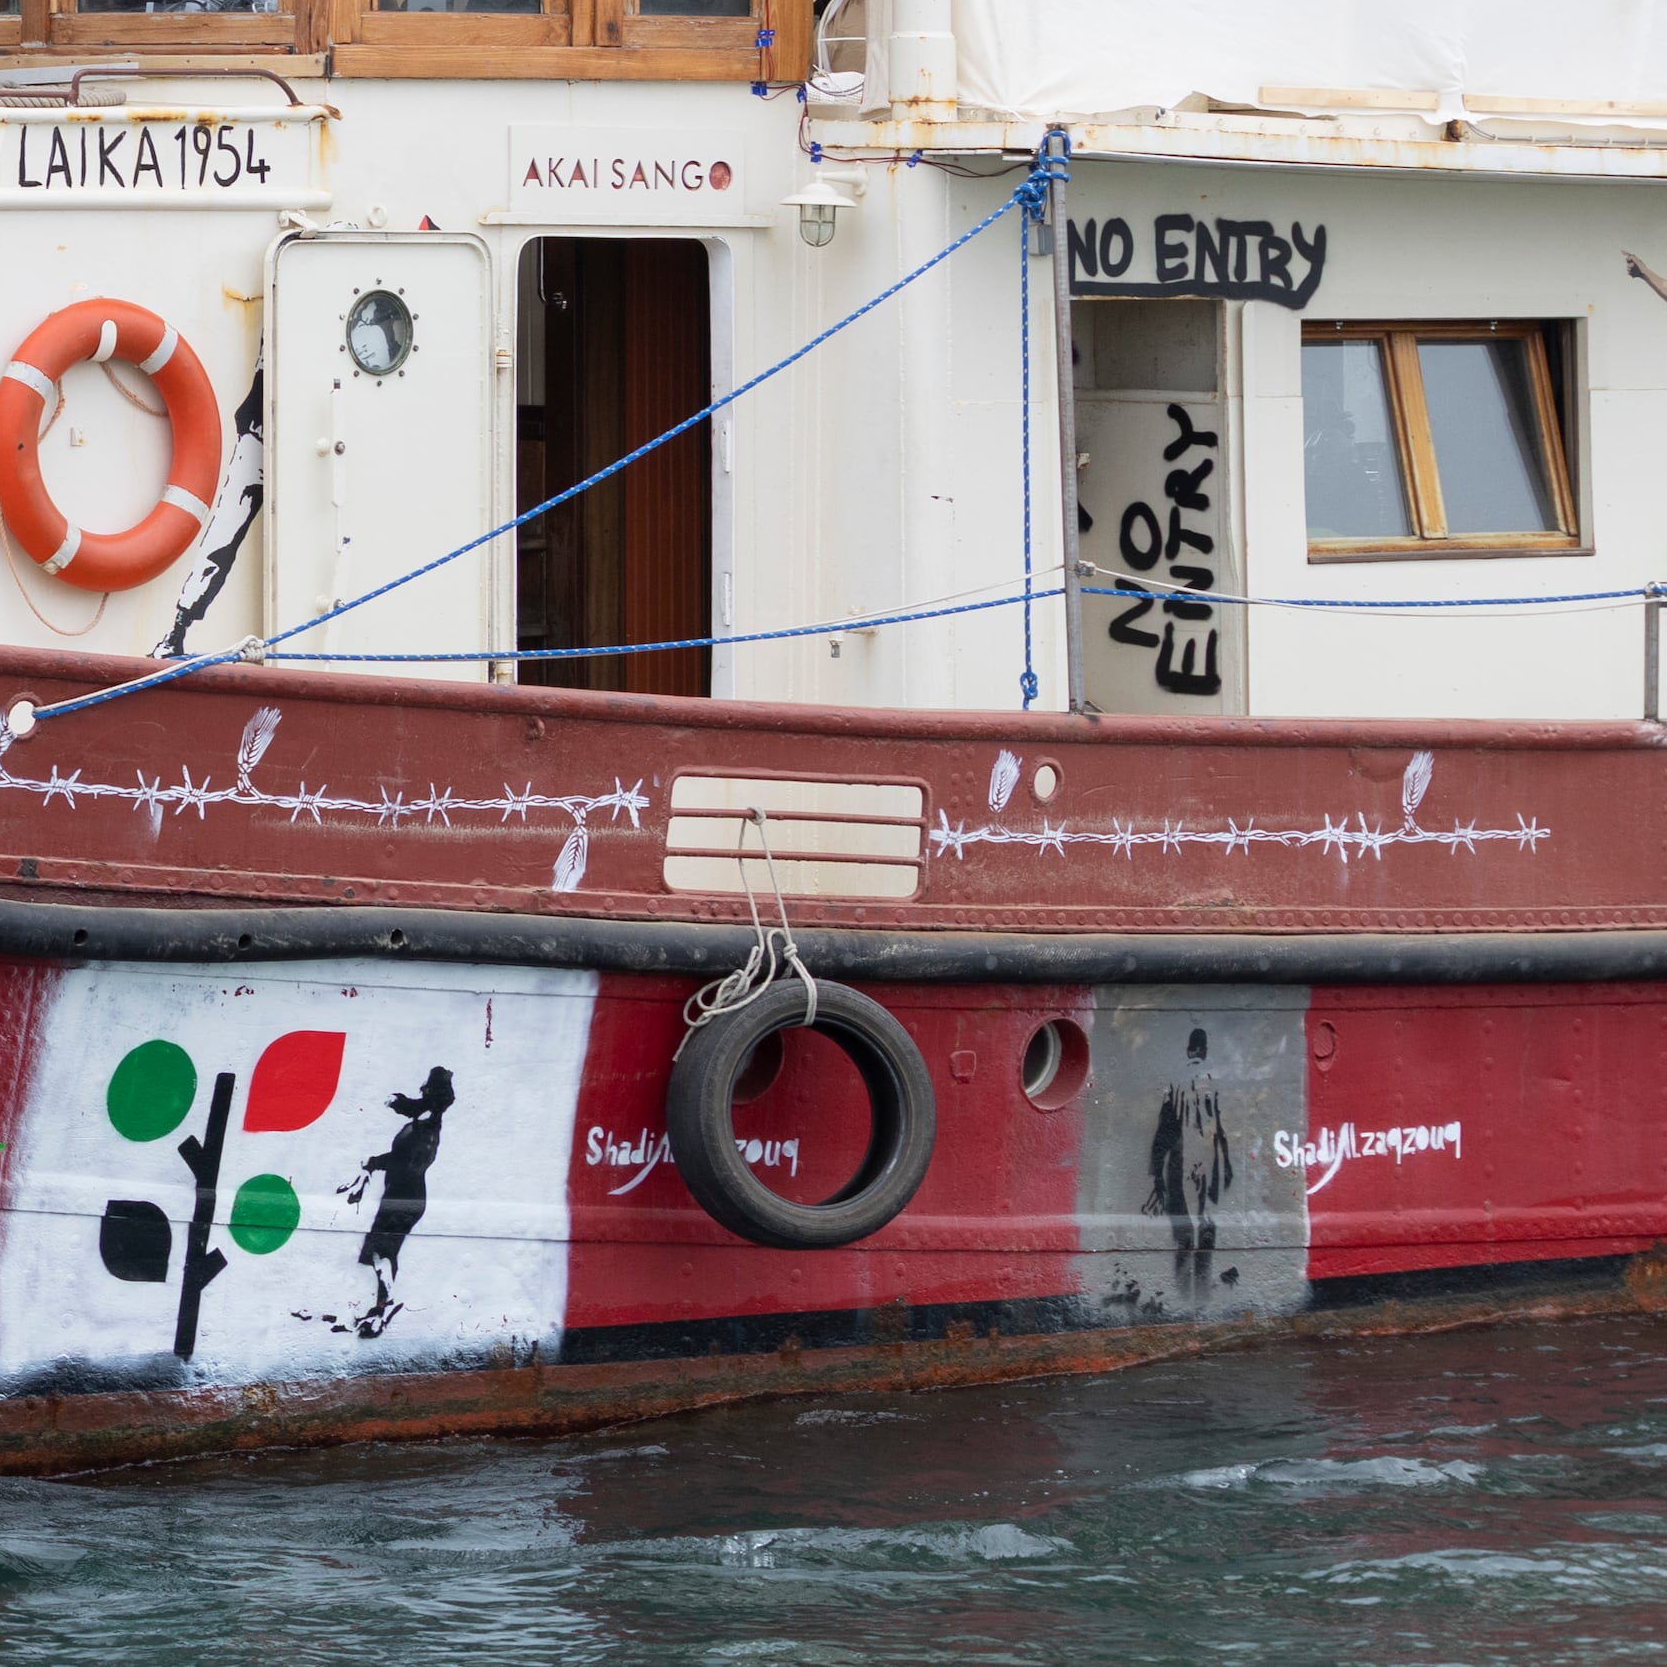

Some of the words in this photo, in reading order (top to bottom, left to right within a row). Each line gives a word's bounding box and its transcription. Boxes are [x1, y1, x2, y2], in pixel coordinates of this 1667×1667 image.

[18, 124, 164, 189] LAIKA
[174, 125, 271, 189] 1954
[523, 157, 598, 188] AKAI
[611, 158, 732, 191] SANGO
[1068, 217, 1134, 278] NO
[1154, 213, 1327, 293] ENTRY
[1109, 502, 1161, 648] NO
[1155, 403, 1221, 695] ENTRY
